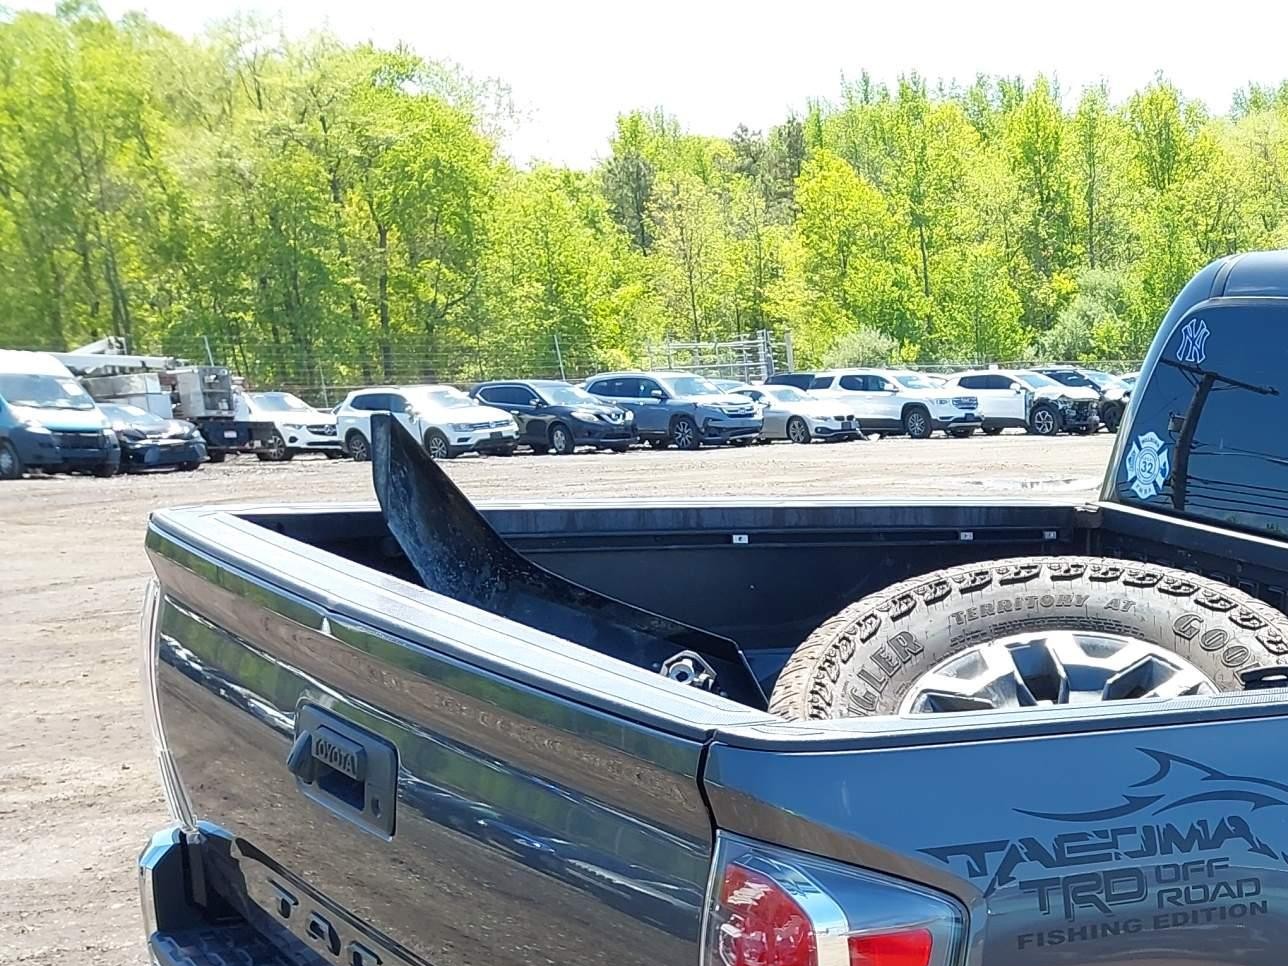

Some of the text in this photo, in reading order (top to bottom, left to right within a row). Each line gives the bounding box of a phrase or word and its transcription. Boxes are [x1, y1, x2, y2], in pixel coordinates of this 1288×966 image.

[1141, 461, 1153, 474] 32
[951, 594, 1137, 626] TERRITORY AT
[314, 738, 357, 776] TOYOTA
[917, 815, 1279, 898] TACOMA
[1018, 857, 1230, 921] TRD OFF
[1157, 877, 1262, 909] ROAD
[1017, 900, 1268, 950] FISHING EDITION
